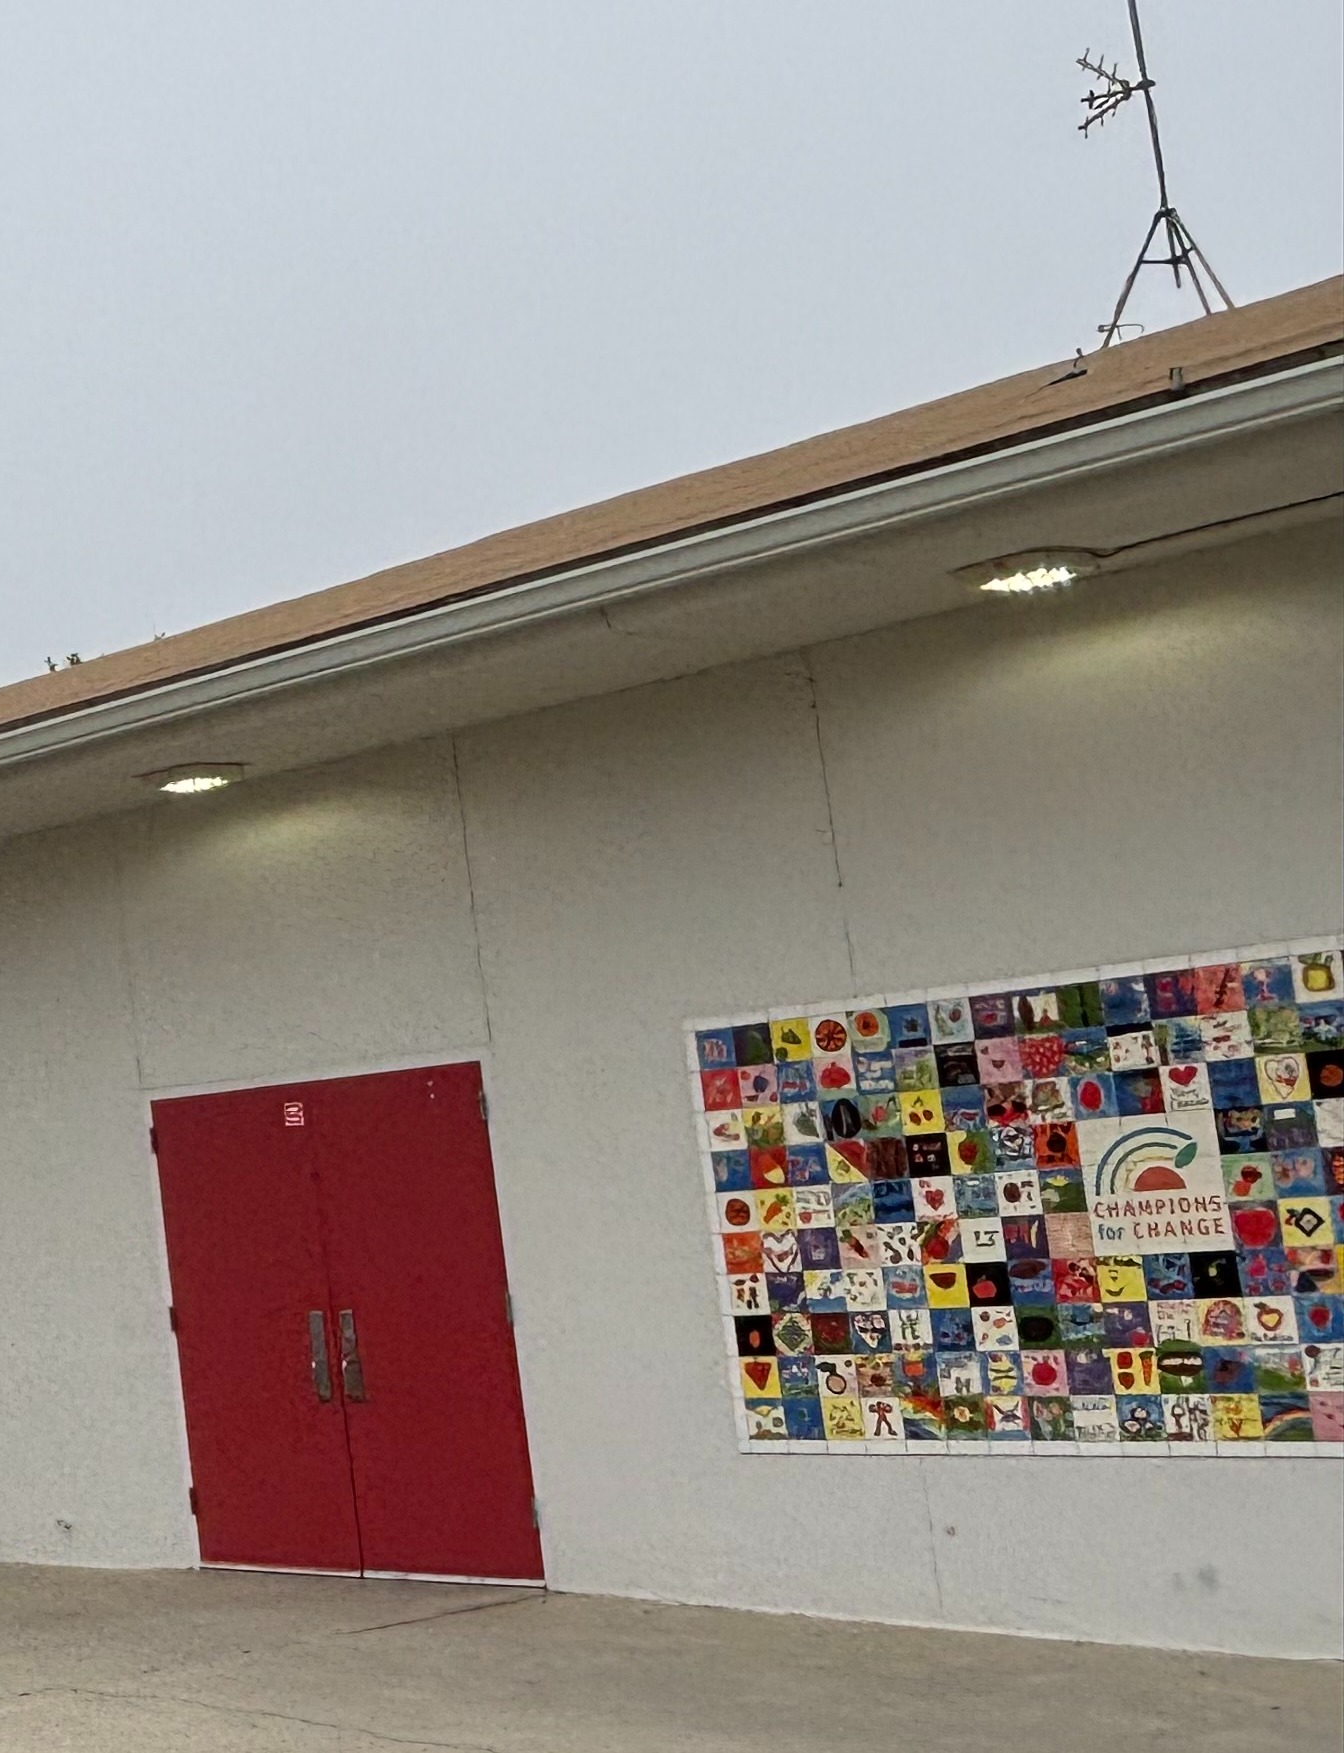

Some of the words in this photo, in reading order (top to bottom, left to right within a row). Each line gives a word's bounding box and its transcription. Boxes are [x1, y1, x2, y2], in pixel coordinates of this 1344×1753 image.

[1093, 1195, 1222, 1219] CHAMPIONS
[1098, 1223, 1125, 1240] for
[1133, 1217, 1226, 1239] CHANGE
